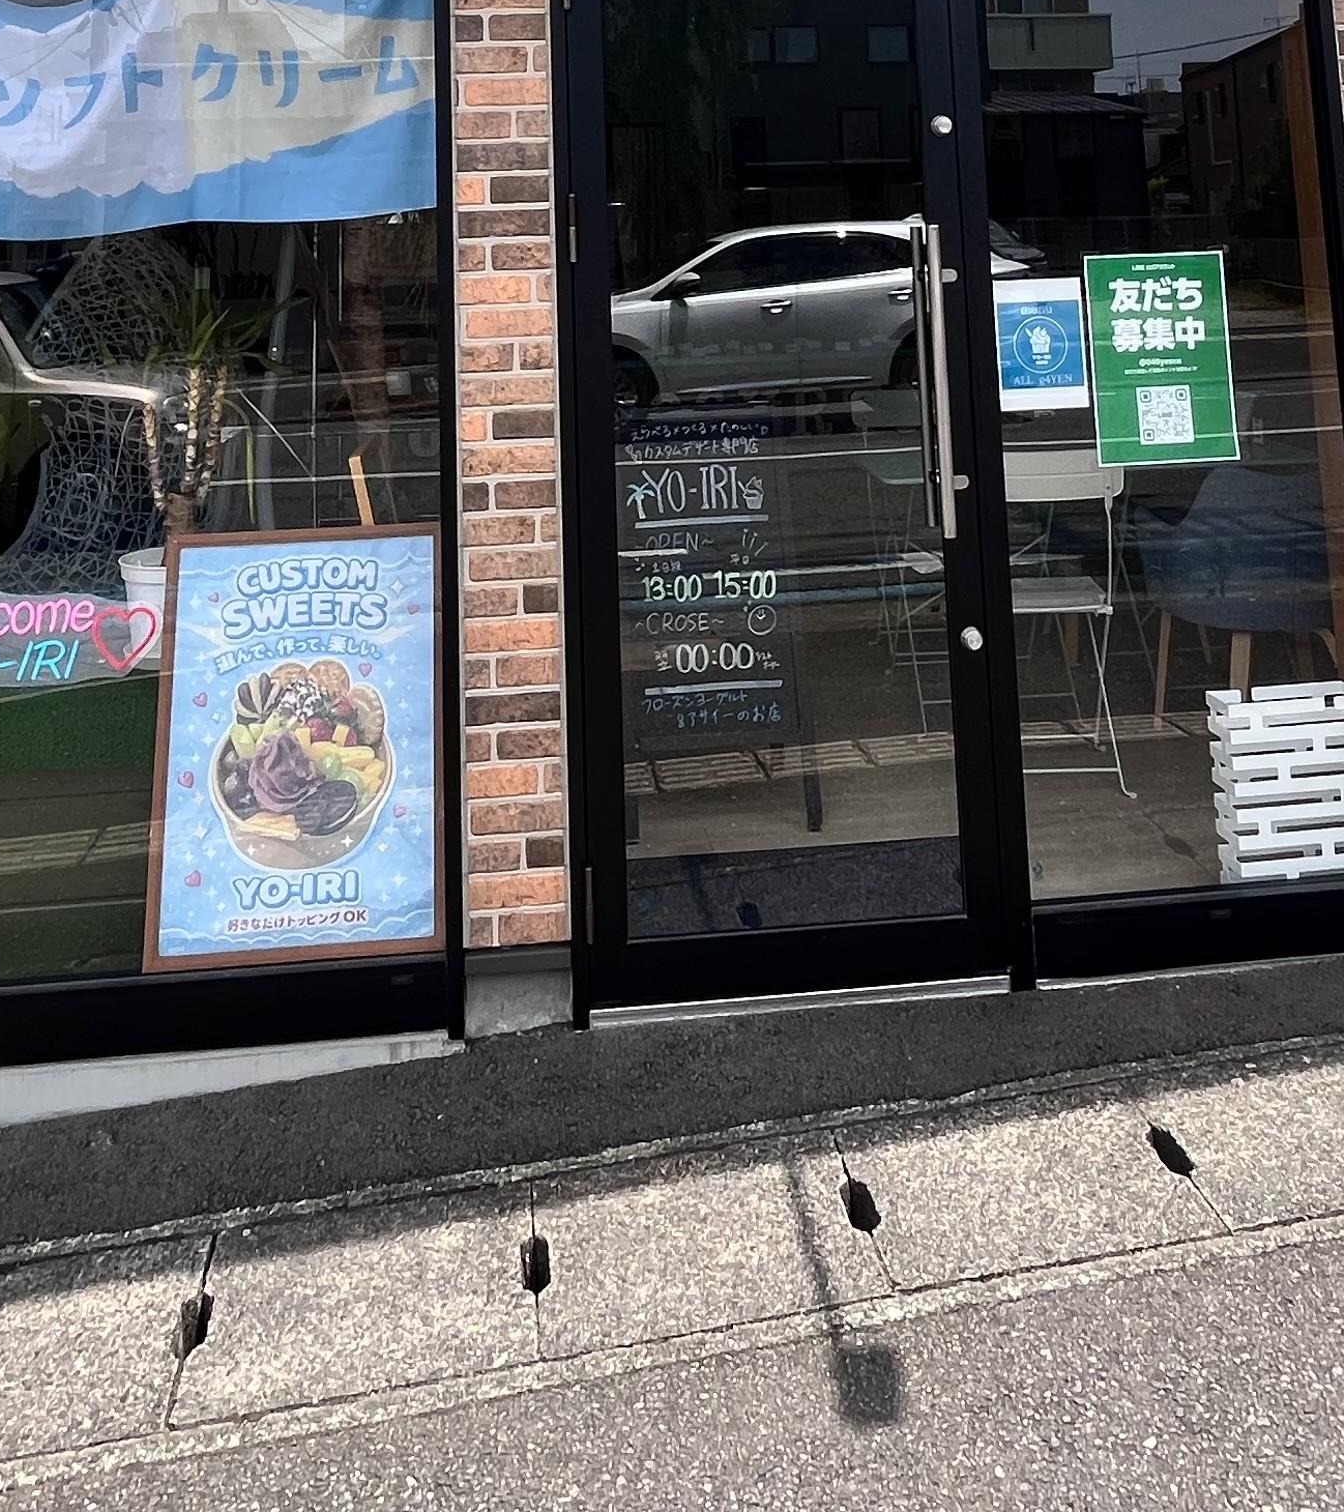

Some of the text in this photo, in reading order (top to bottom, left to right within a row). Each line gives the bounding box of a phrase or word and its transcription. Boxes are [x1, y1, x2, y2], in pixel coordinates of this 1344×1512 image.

[1108, 276, 1203, 313] 友だち
[1110, 315, 1206, 353] 募集中
[1013, 375, 1036, 385] ALL
[642, 465, 739, 514] YO-IRI
[237, 558, 378, 595] CUSTOM
[642, 570, 777, 603] 13:00 15:00
[222, 591, 388, 639] SWEETS
[676, 642, 754, 674] 00:00
[233, 871, 360, 910] YO-IRI
